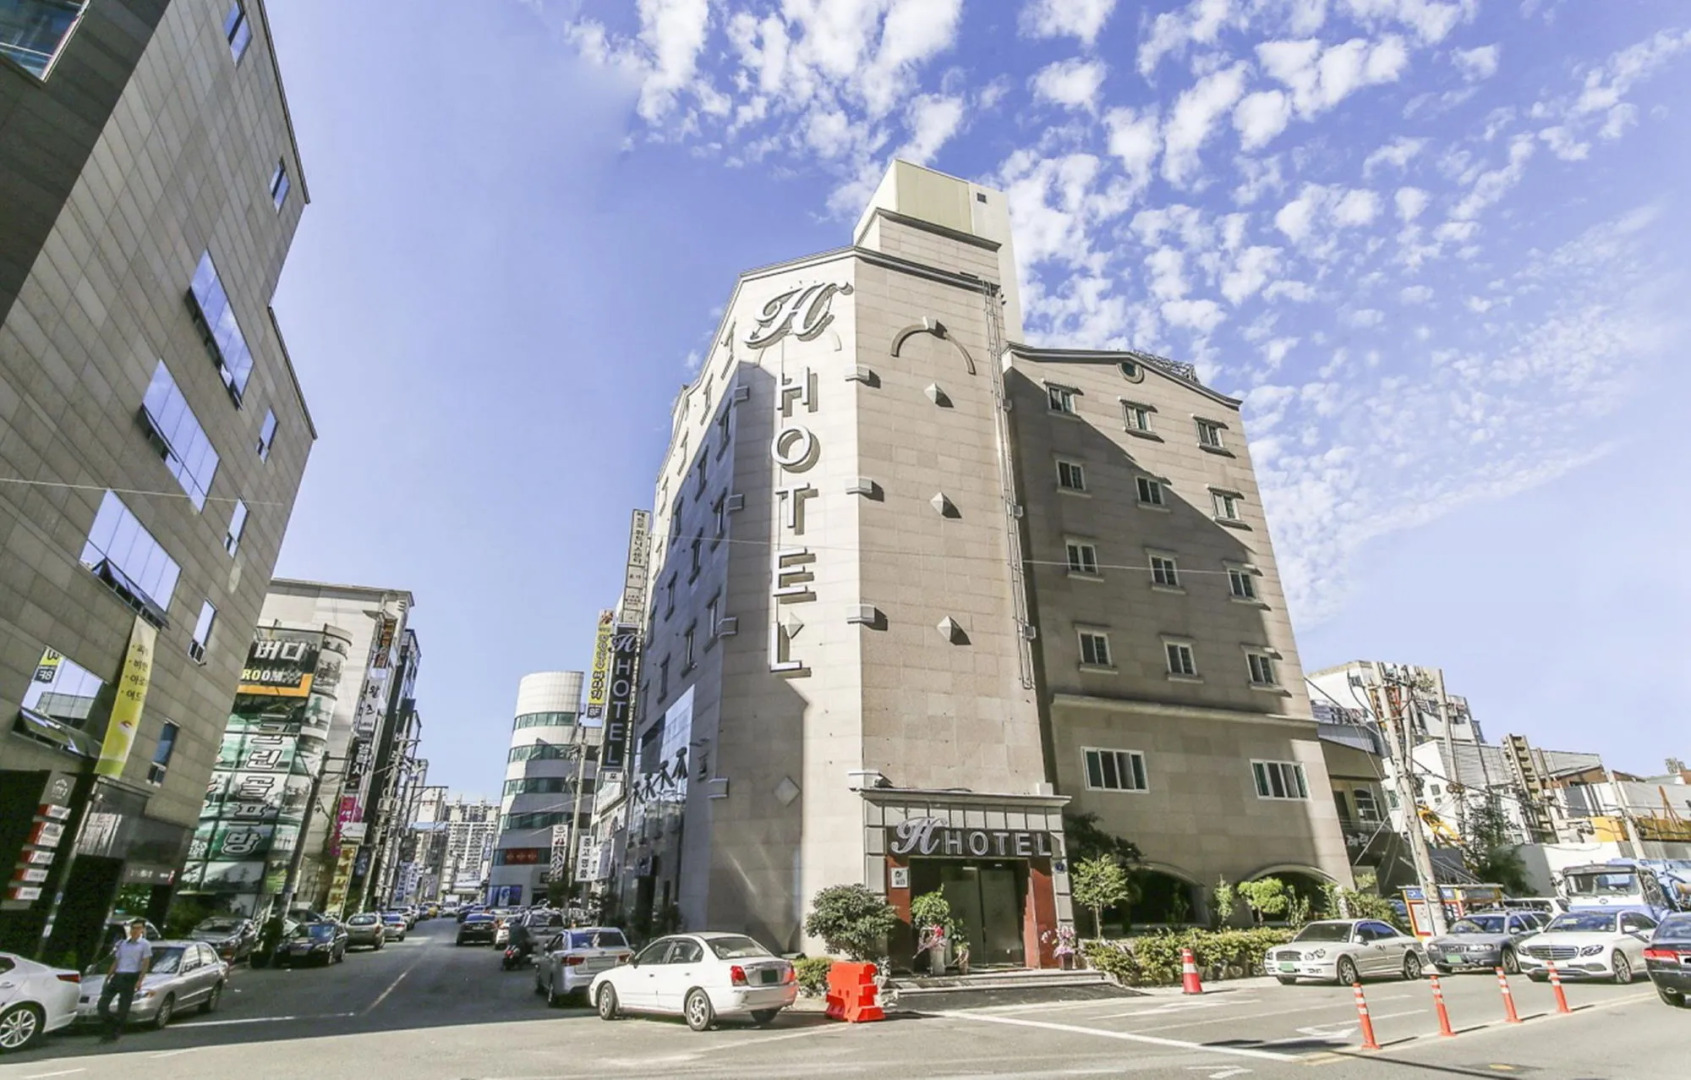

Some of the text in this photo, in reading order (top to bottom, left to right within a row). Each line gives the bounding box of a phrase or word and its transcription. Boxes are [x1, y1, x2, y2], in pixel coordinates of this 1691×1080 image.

[770, 366, 814, 672] HOTEL
[241, 669, 284, 682] ROOM
[607, 658, 631, 764] HOTEL
[944, 831, 1051, 856] HOTEL
